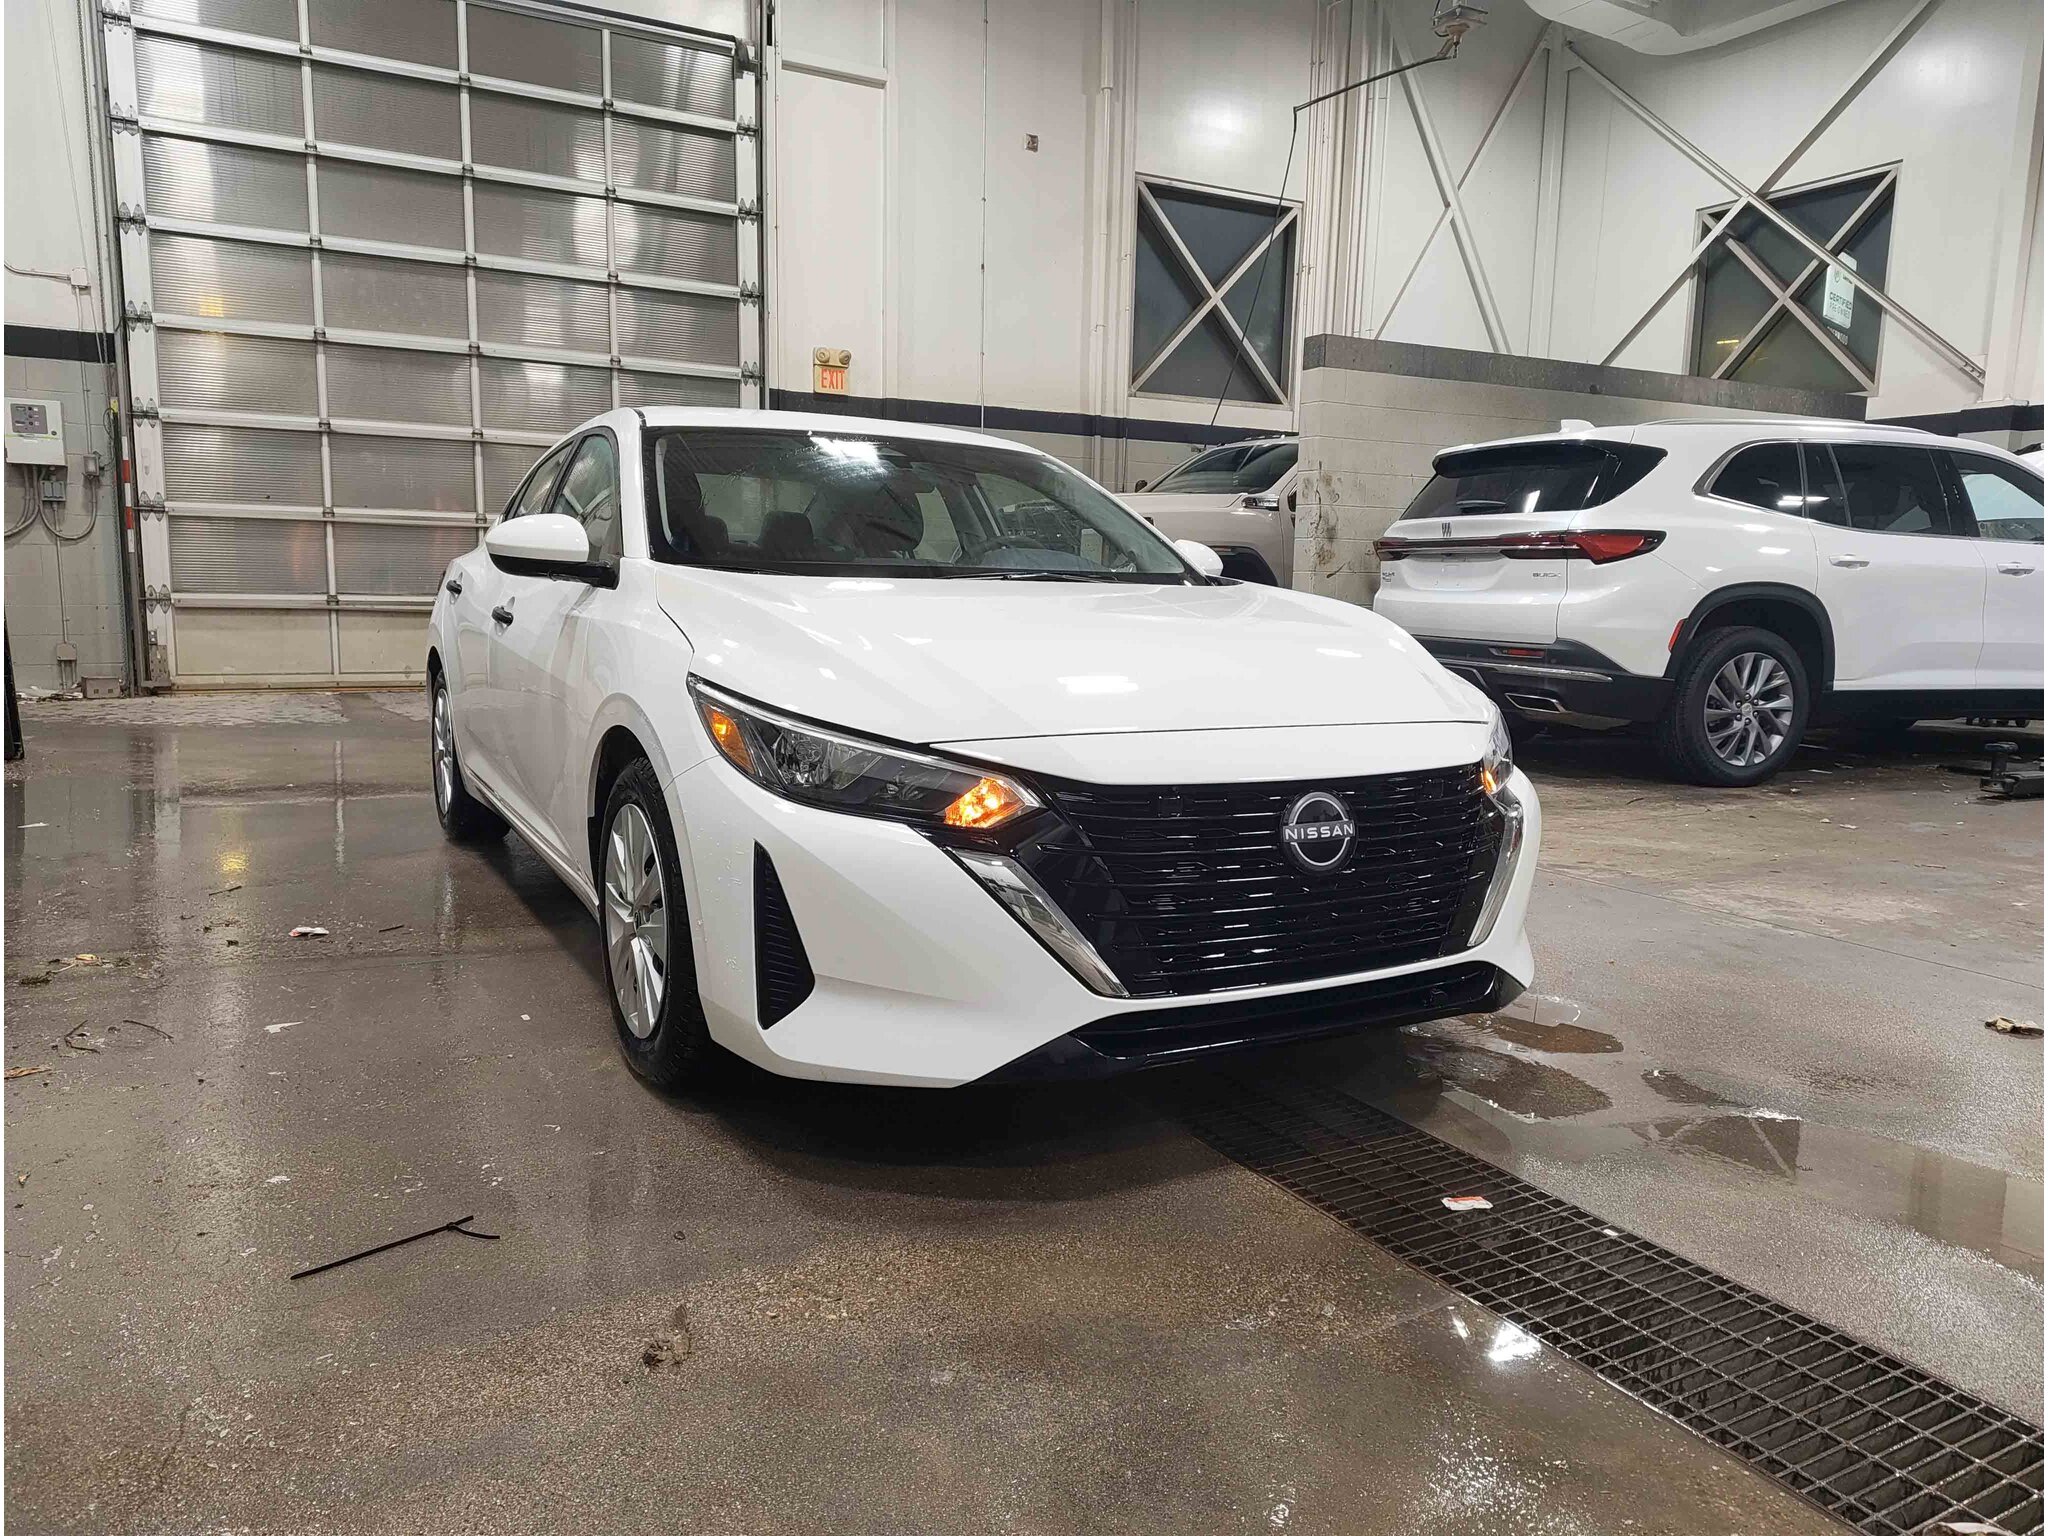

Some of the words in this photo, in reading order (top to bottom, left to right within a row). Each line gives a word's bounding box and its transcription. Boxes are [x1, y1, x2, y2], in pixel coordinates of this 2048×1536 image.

[1829, 292, 1852, 310] CERTIFIED
[821, 368, 844, 389] EXIT
[1285, 824, 1353, 840] NISSAN
